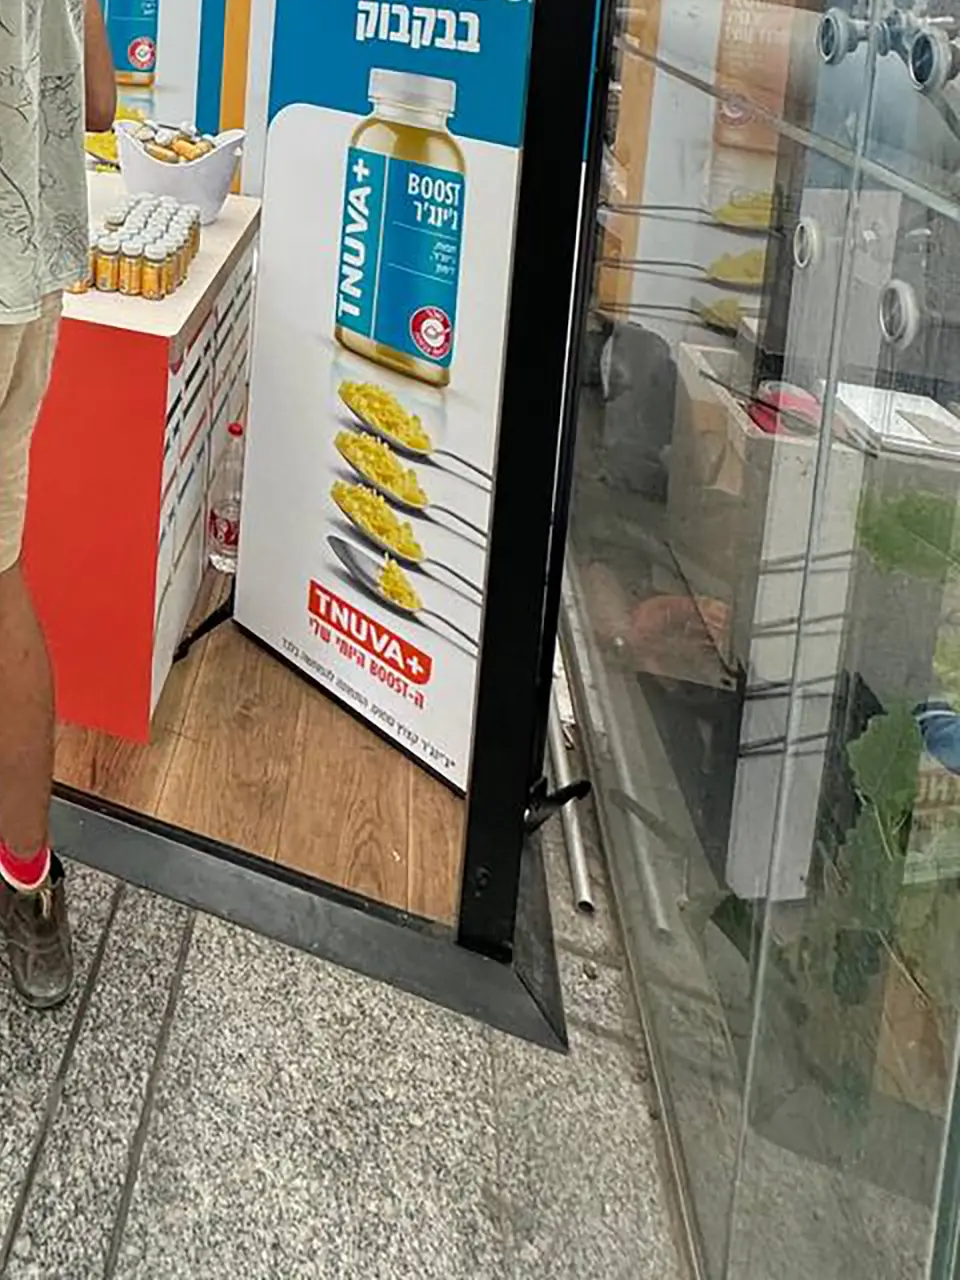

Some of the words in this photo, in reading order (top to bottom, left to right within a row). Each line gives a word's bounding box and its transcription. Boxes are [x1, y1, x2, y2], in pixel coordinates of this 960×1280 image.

[354, 0, 481, 53] בבקבוק
[407, 172, 461, 206] BOOST
[337, 157, 373, 318] TNUVA+
[315, 589, 425, 676] TNUVA+
